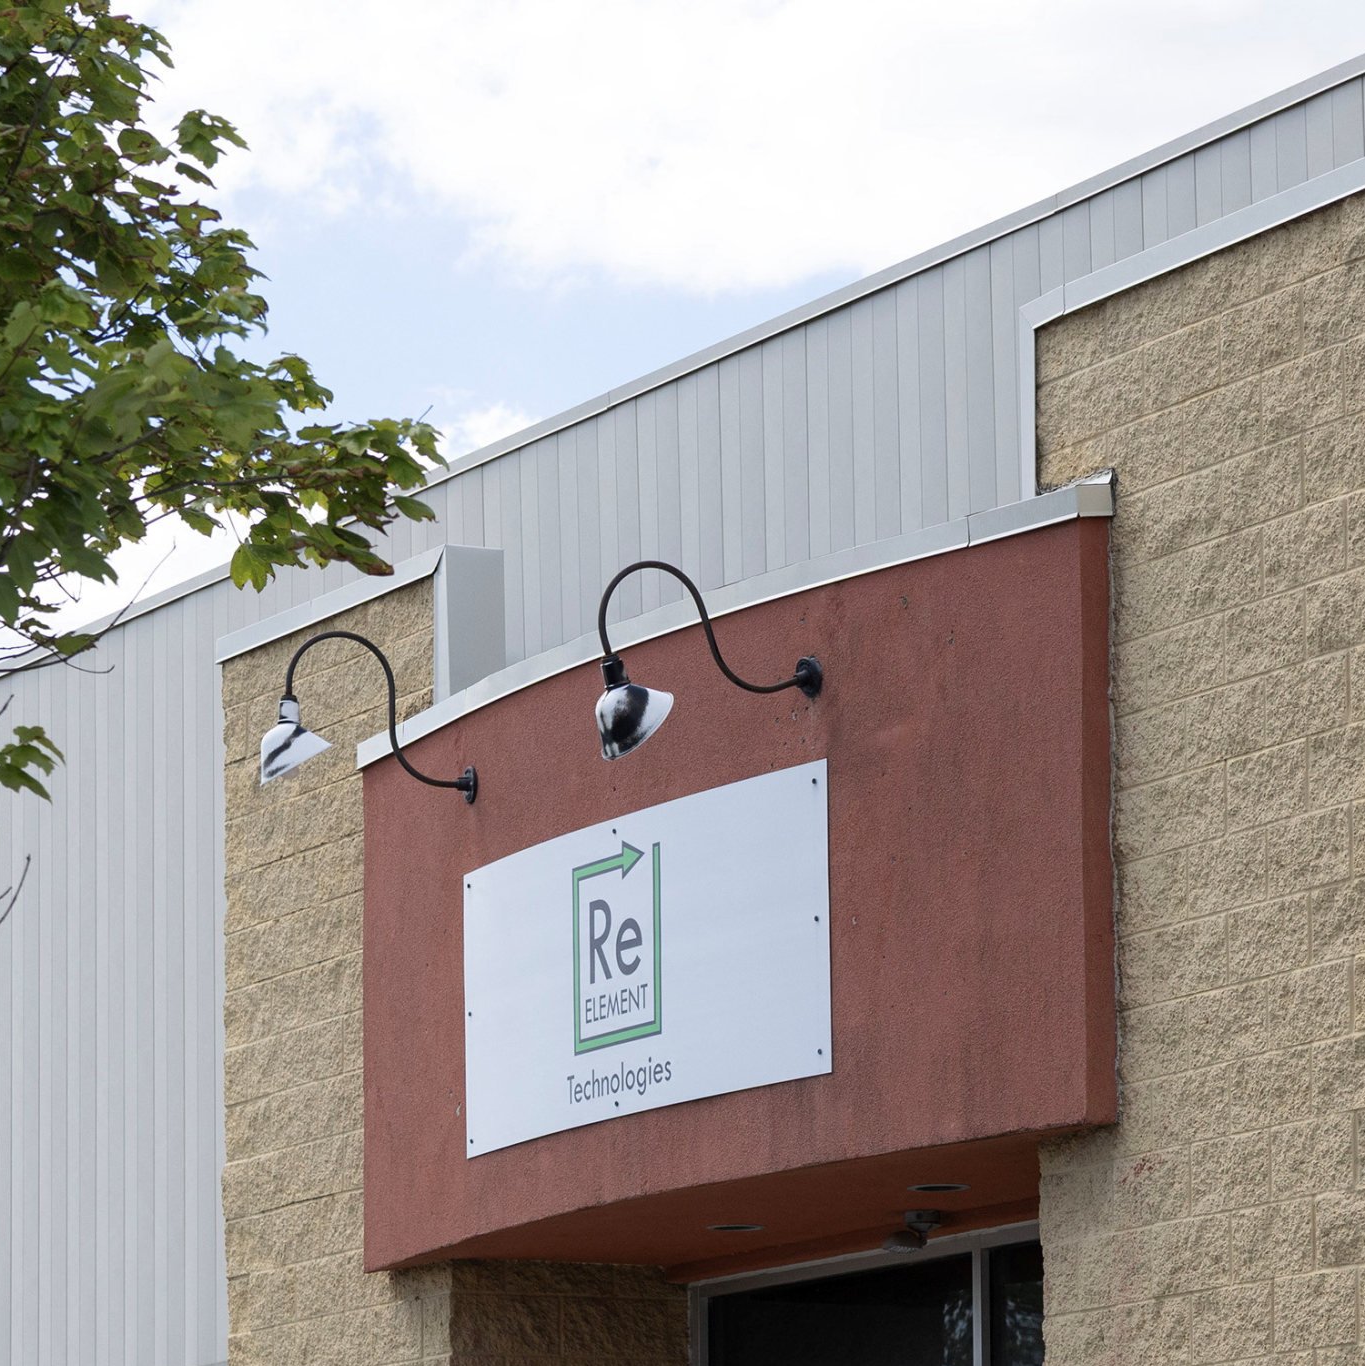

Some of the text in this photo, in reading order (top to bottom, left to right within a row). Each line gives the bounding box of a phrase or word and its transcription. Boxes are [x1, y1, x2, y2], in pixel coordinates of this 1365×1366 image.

[588, 898, 643, 985] Re
[585, 983, 648, 1024] ELEMENT
[566, 1056, 672, 1105] Technologies
